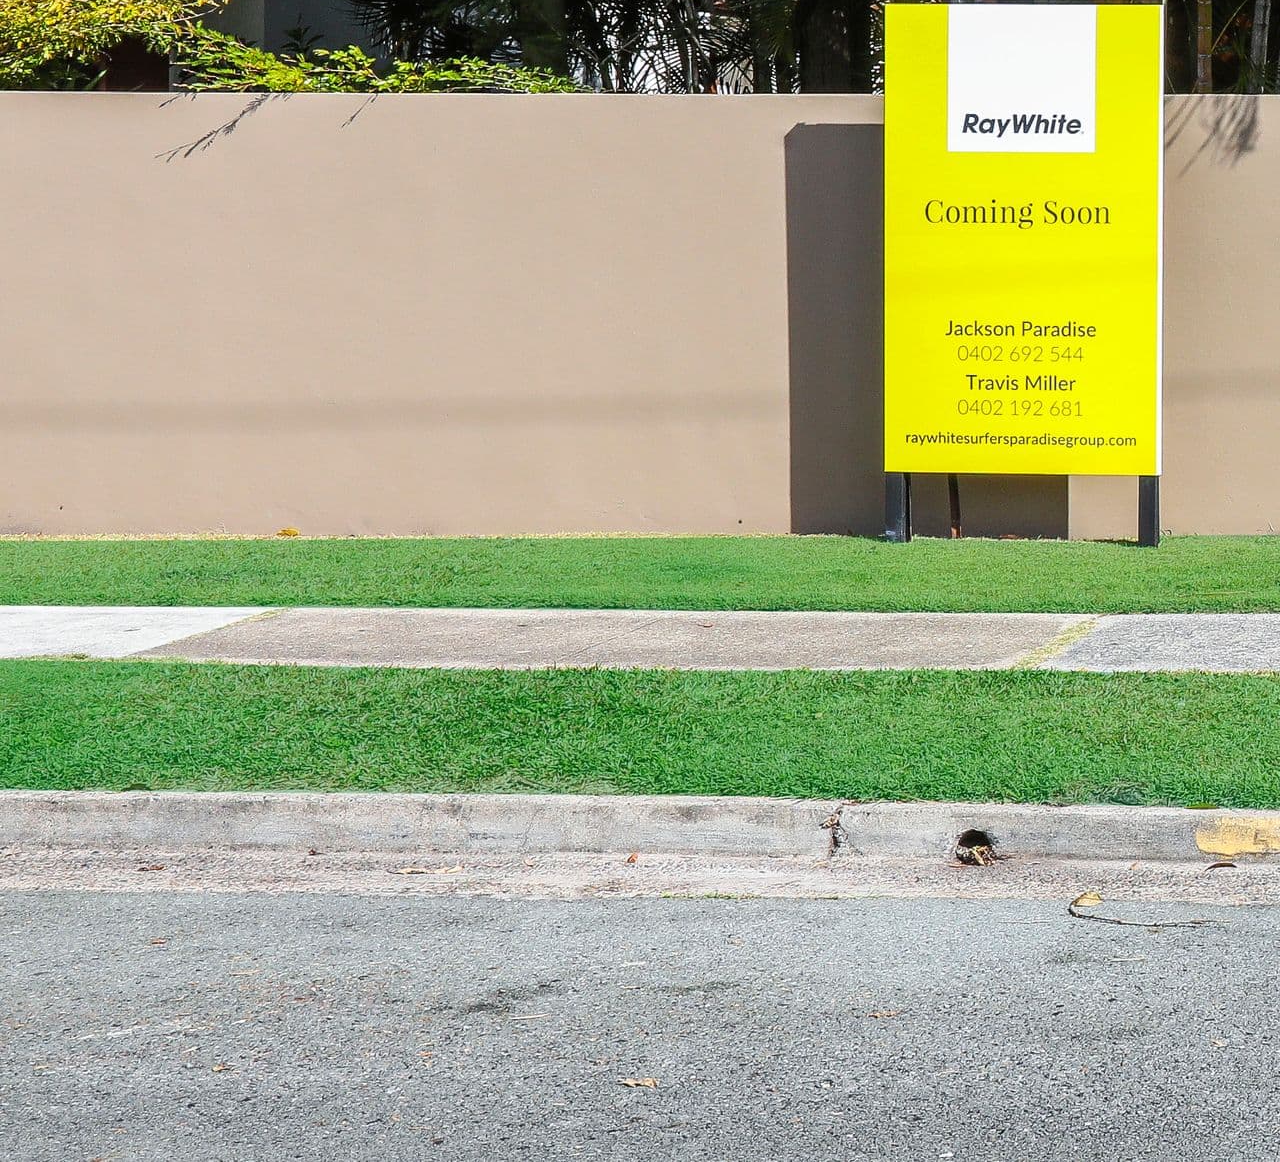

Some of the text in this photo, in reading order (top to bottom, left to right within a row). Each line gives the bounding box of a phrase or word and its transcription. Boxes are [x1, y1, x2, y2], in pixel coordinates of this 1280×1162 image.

[925, 199, 1111, 229] Coming Soon
[945, 320, 1097, 338] Jackson Paradise
[957, 345, 1084, 362] 0402 692 544
[965, 374, 1076, 391] Travis Miller
[957, 399, 1083, 417] 0402 192 681
[905, 432, 1137, 449] raywhitesurfersparadisegroup.com
